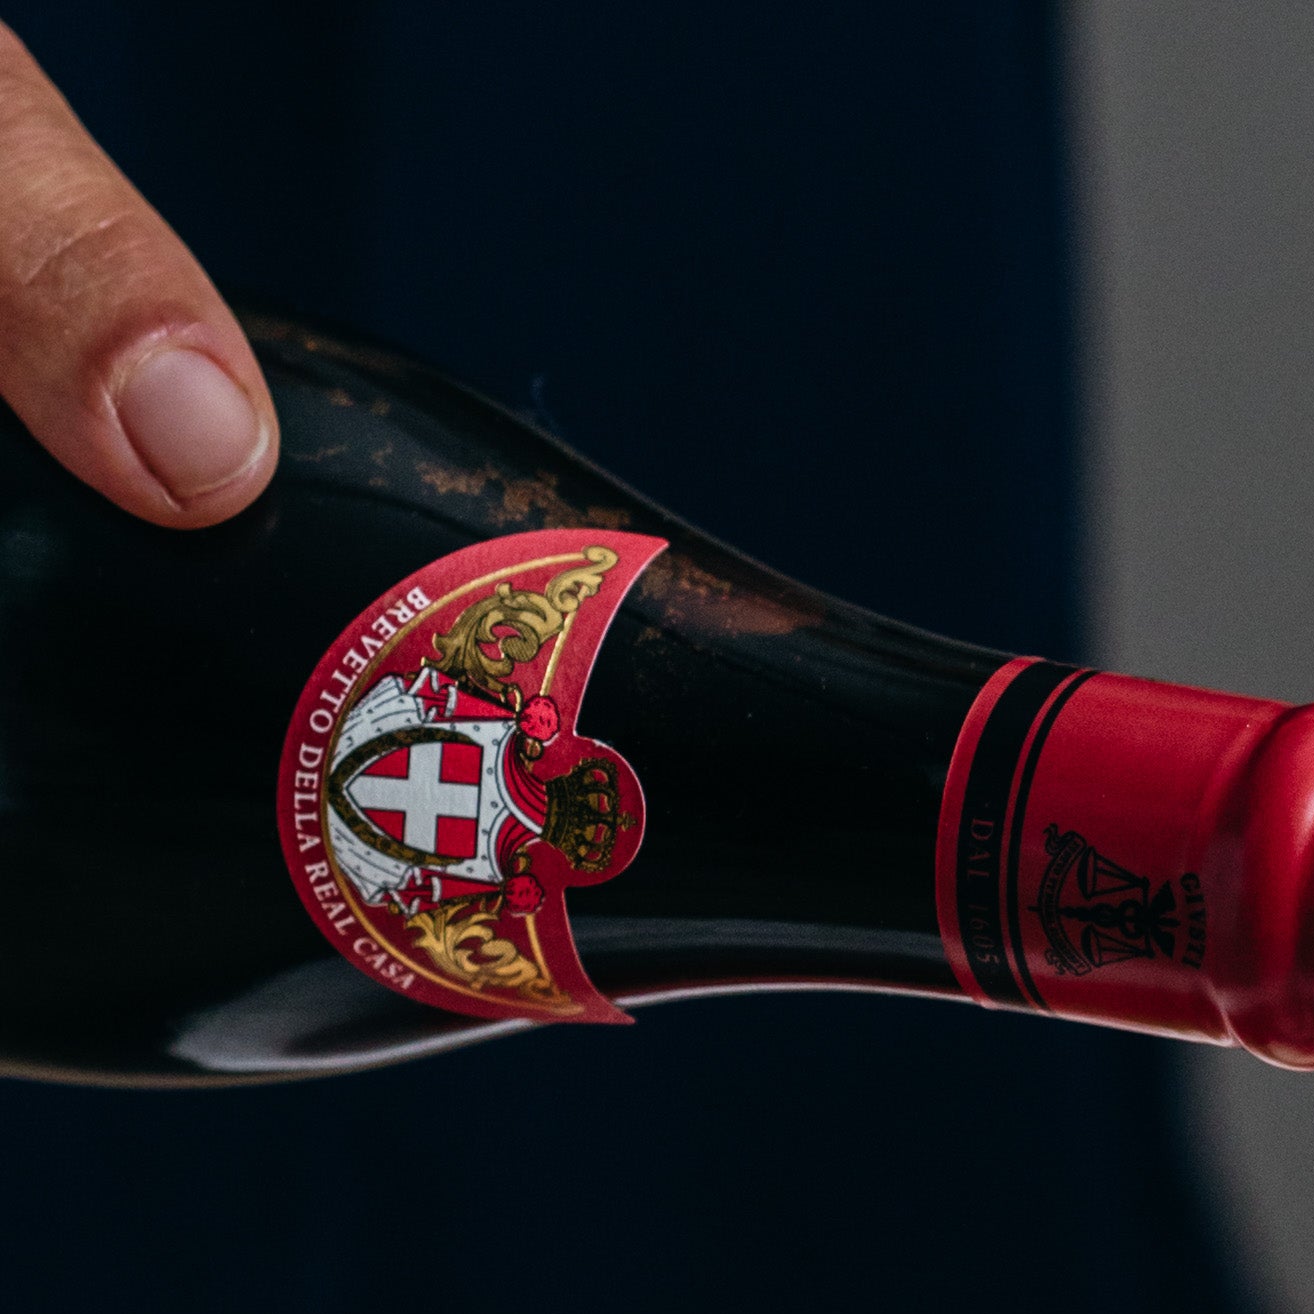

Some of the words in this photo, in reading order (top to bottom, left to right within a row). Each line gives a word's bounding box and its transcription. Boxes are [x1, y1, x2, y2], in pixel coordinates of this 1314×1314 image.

[309, 587, 430, 734] BREVETTO
[294, 744, 322, 851] DELLA
[967, 818, 994, 880] DAL
[305, 860, 356, 935] REAL
[354, 937, 417, 990] CASA
[968, 904, 999, 965] 1605
